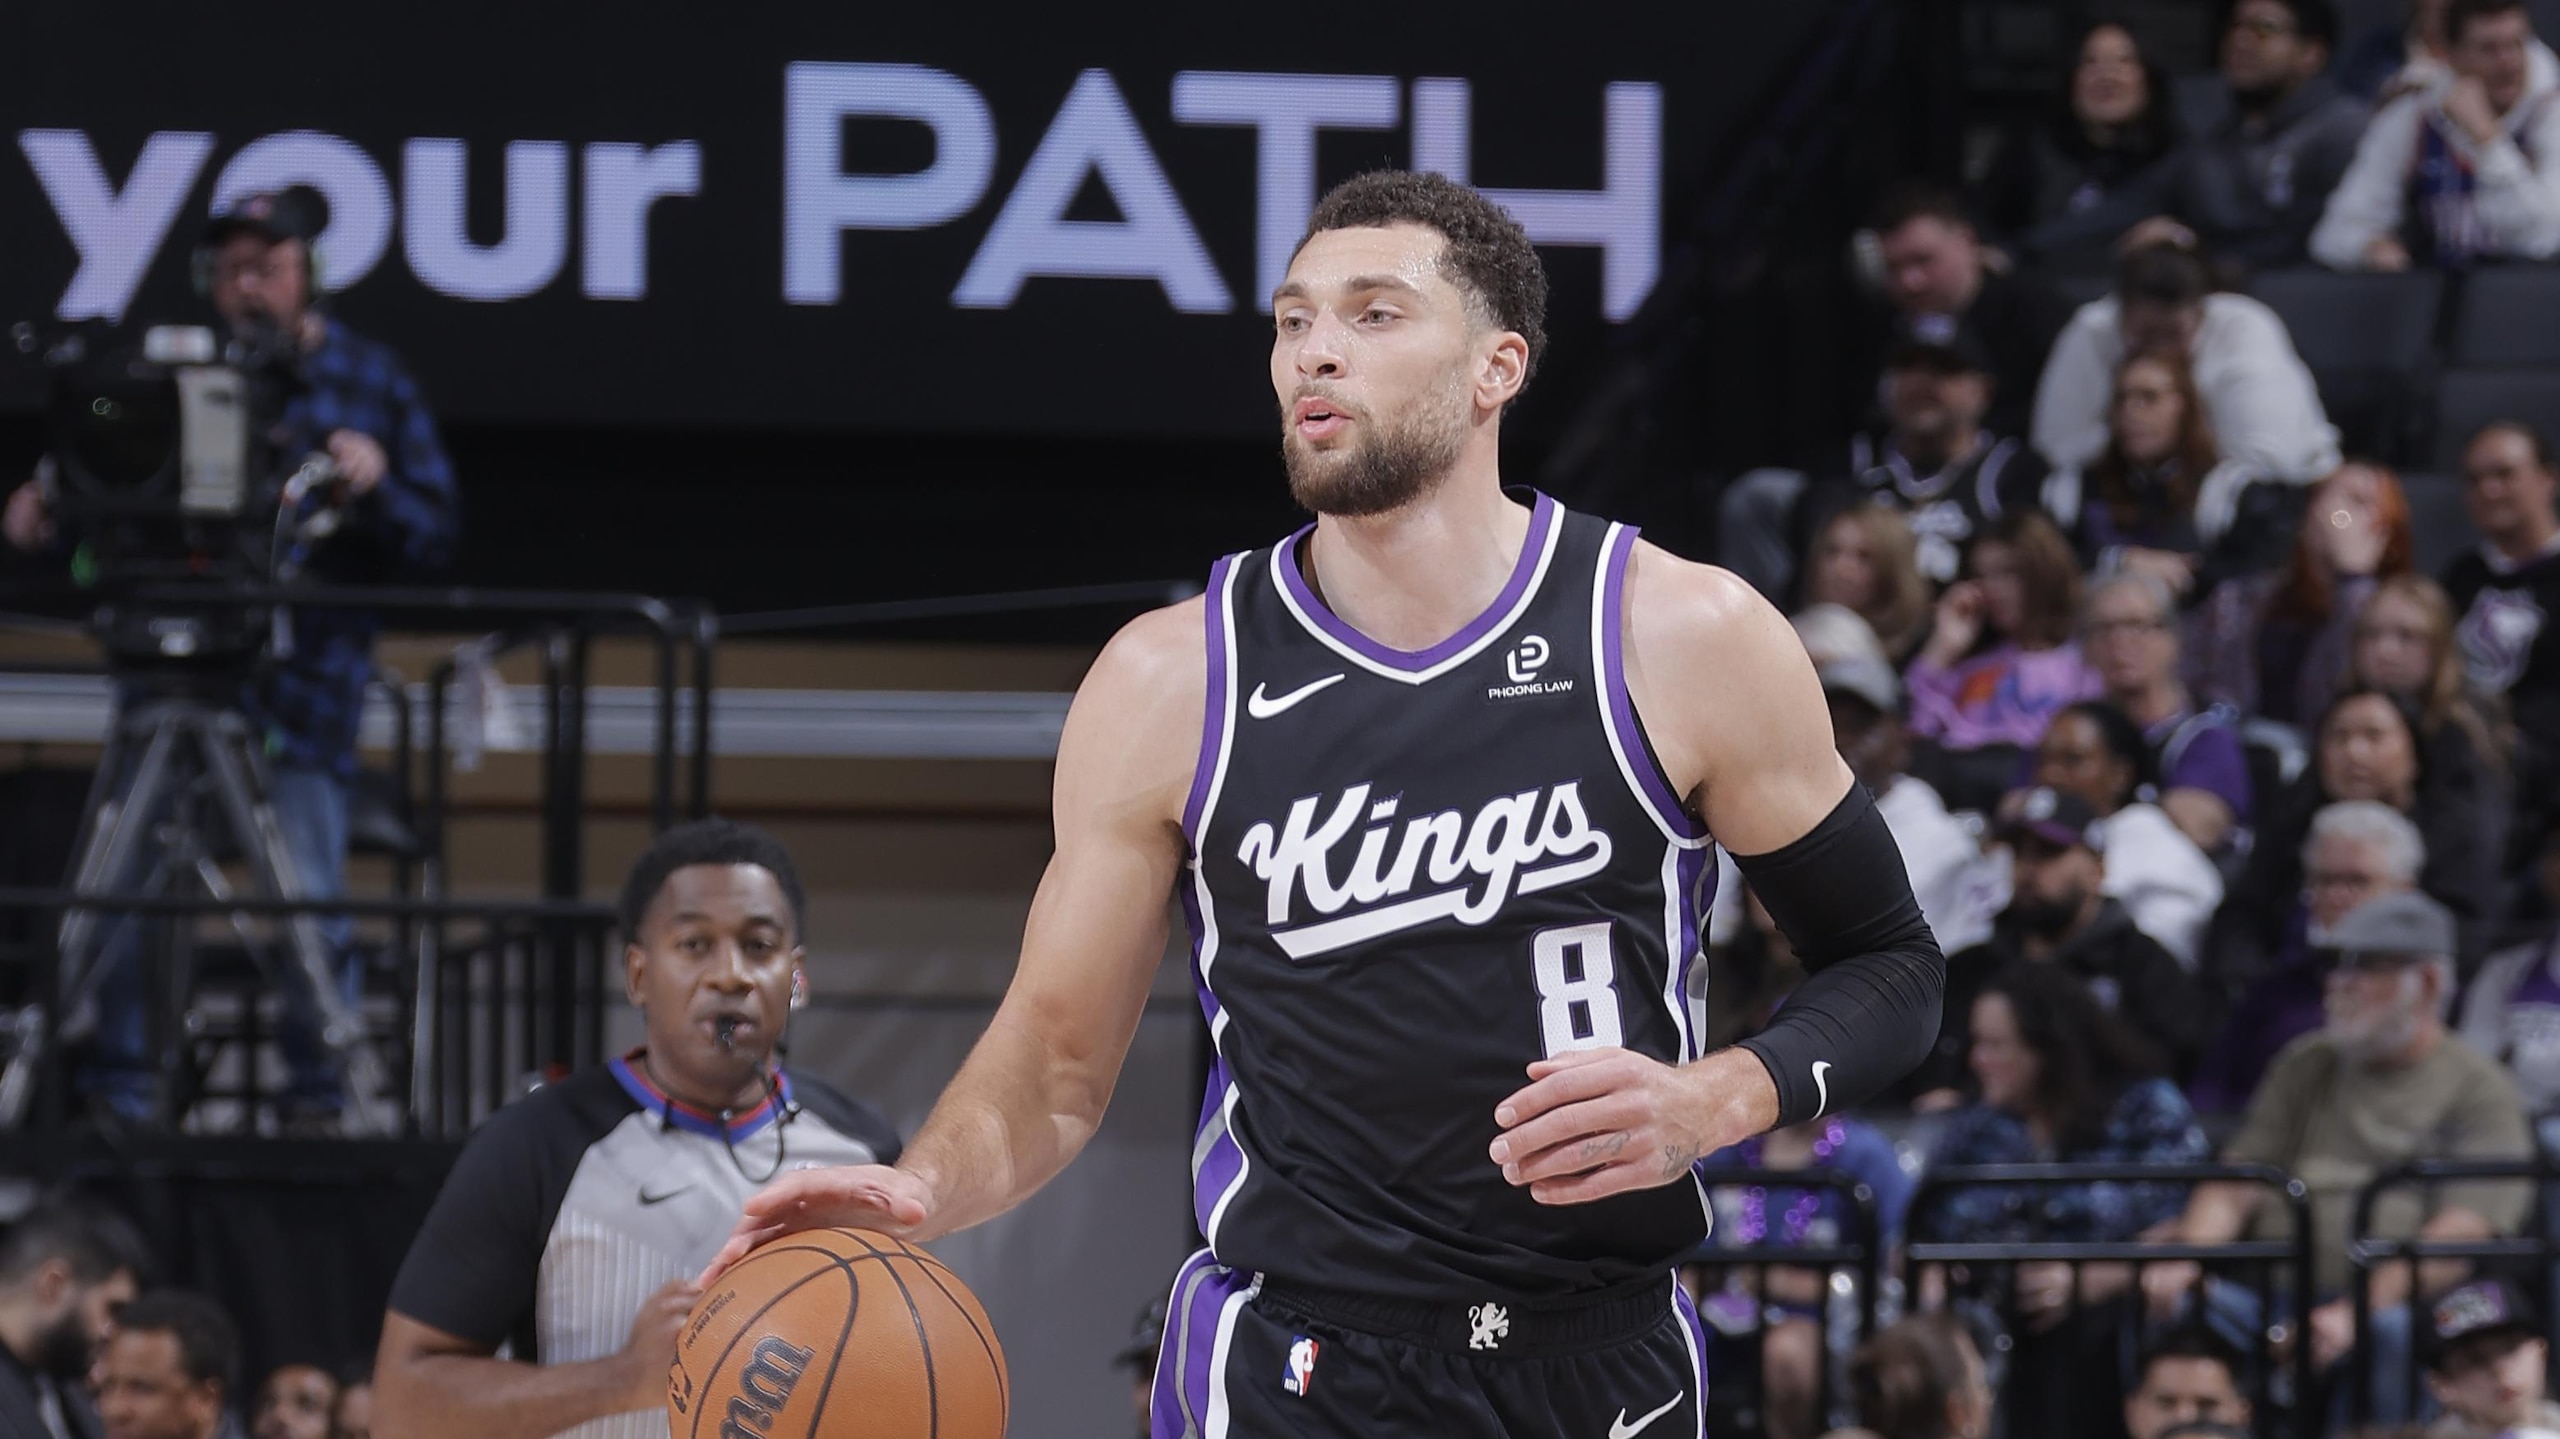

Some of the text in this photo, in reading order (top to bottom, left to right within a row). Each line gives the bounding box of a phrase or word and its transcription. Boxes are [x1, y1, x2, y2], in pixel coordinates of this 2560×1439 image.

[18, 60, 1664, 323] your PATH
[1488, 680, 1573, 699] PHOONG LAW
[1237, 780, 1612, 960] Kings
[1529, 919, 1626, 1062] 8
